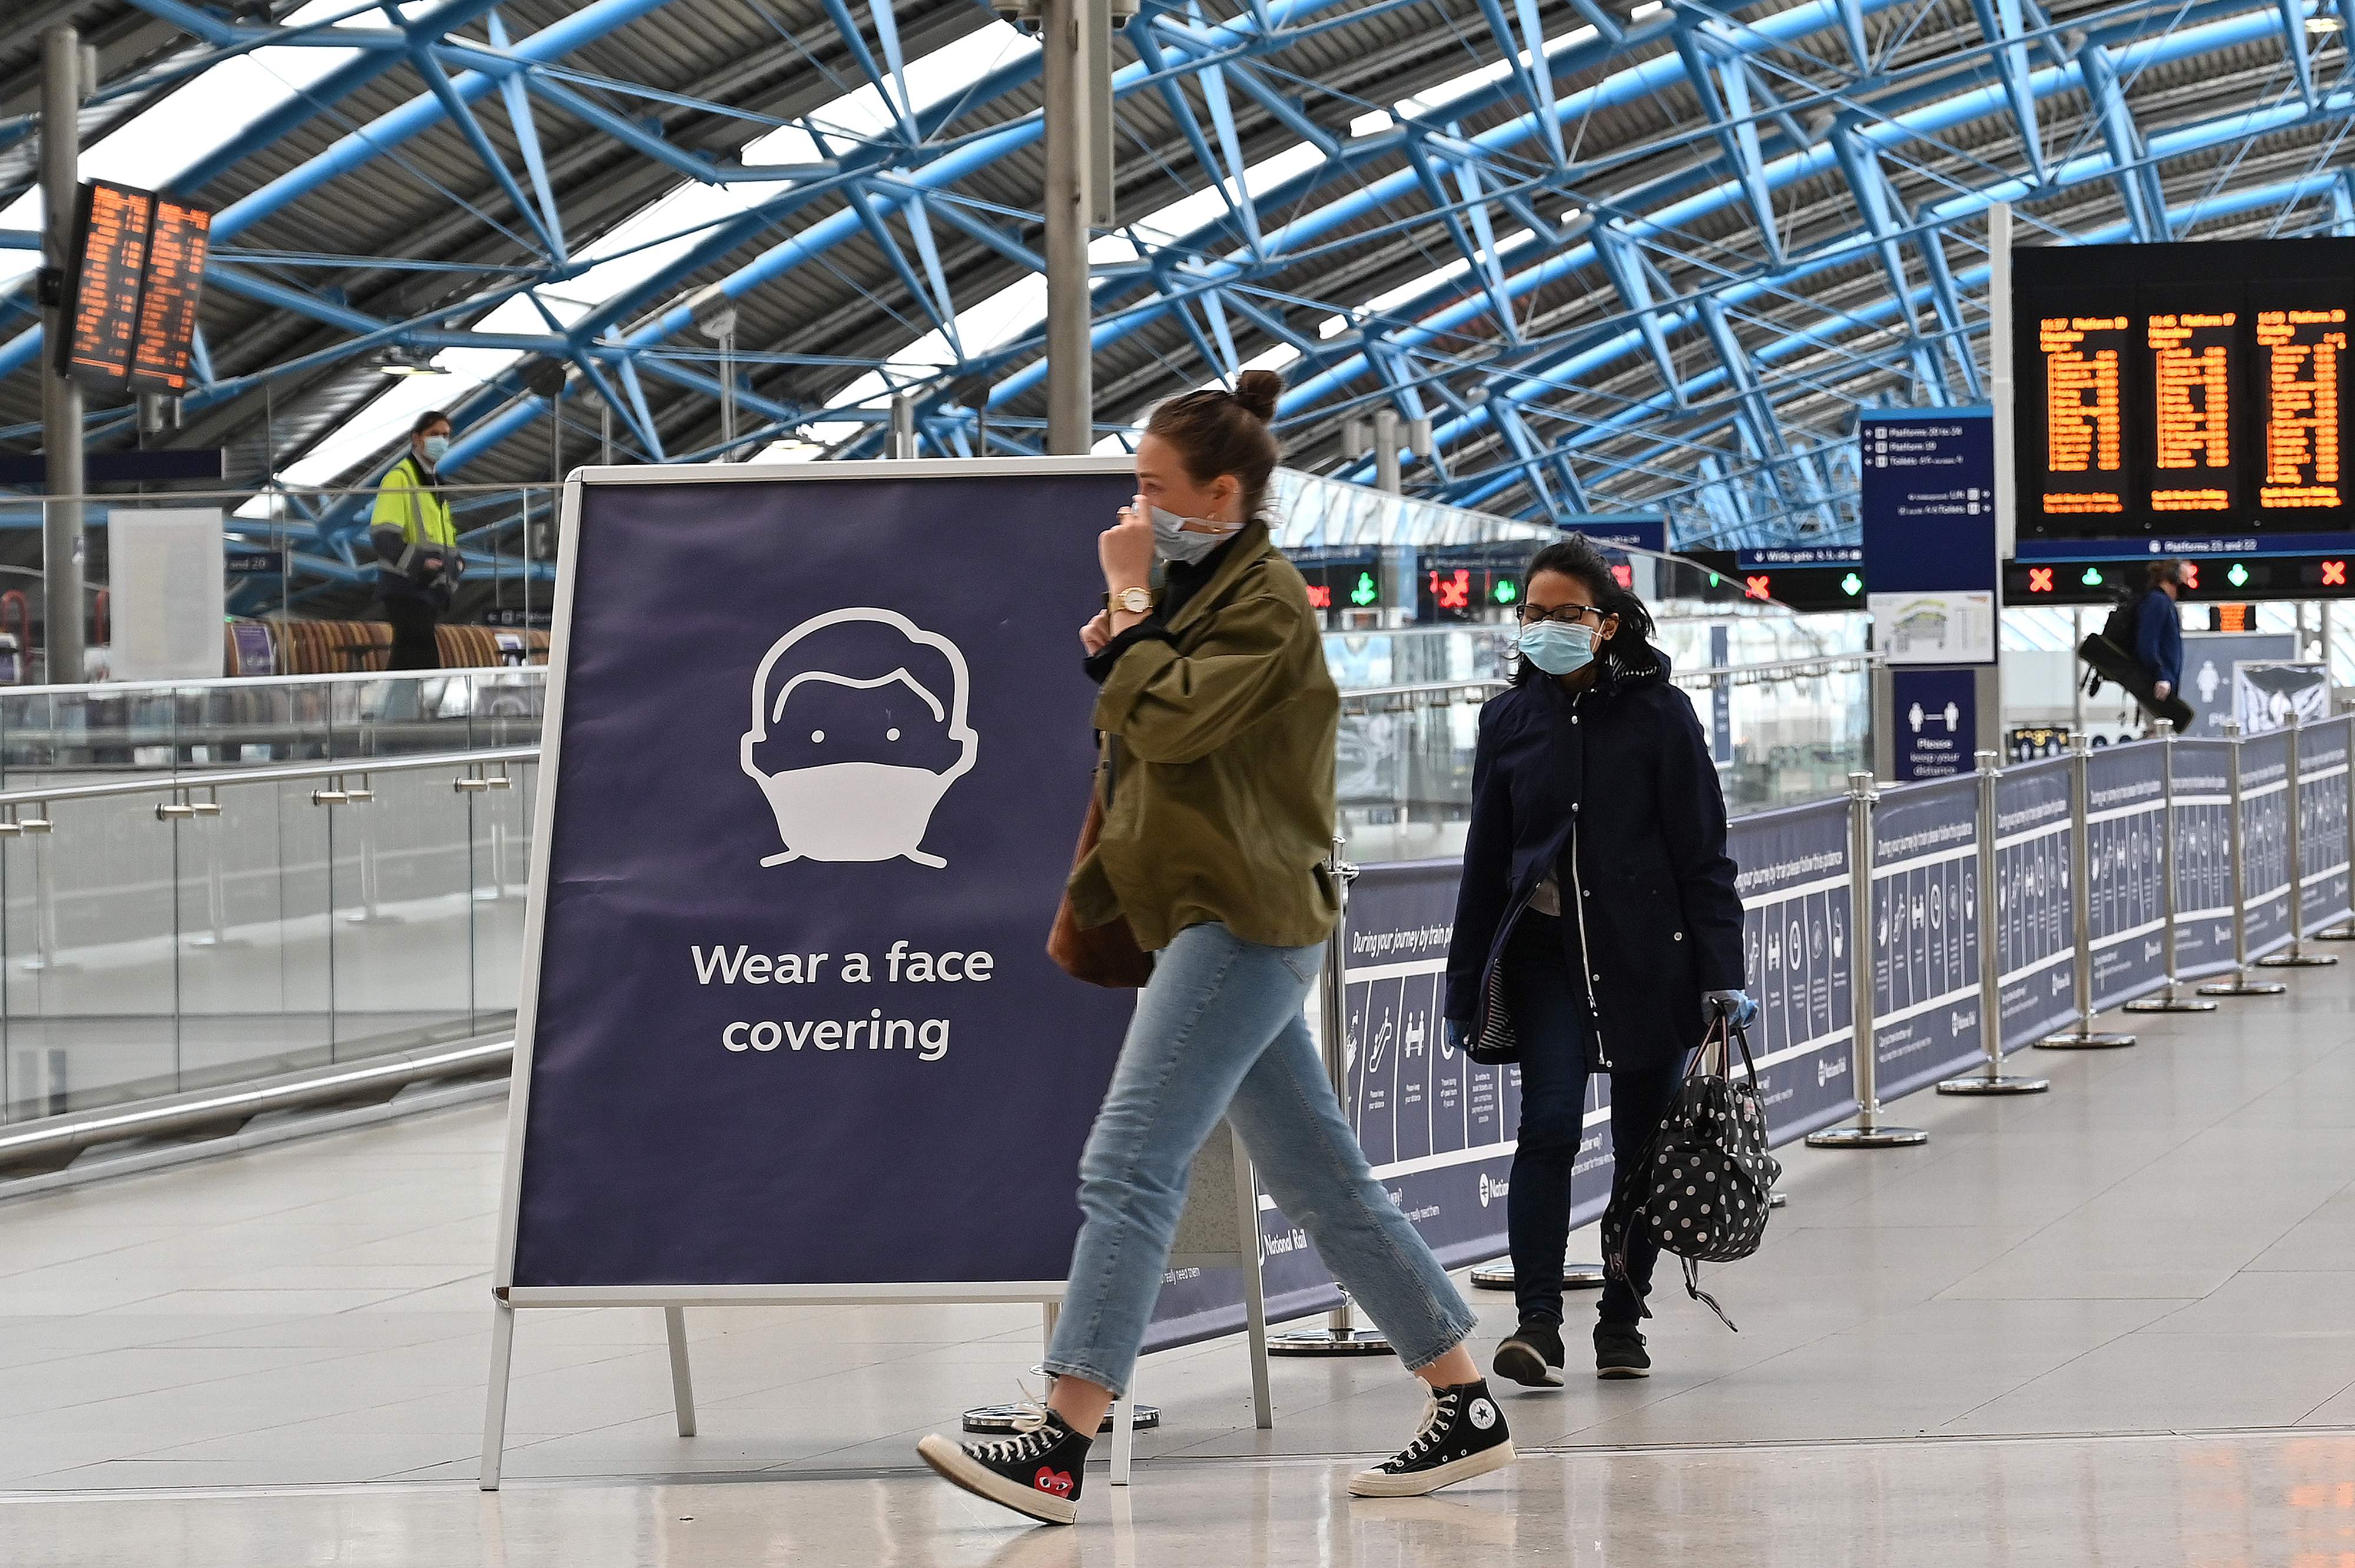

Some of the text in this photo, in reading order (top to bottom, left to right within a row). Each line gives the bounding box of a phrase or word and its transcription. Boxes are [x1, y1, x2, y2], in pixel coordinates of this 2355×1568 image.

[1889, 427, 1928, 438] Platforms
[1889, 442, 1925, 452] Platform
[2164, 541, 2210, 552] Platforms
[2224, 539, 2243, 551] and
[1791, 551, 1815, 563] gate
[1917, 738, 1953, 750] Please
[1910, 751, 1960, 765] keep your
[1913, 765, 1958, 776] distance
[1353, 930, 1377, 958] During
[1375, 932, 1394, 957] your
[1391, 927, 1420, 954] journey
[1419, 925, 1429, 952] by
[1428, 923, 1444, 946] train
[690, 940, 995, 985] Wear a face
[722, 1007, 951, 1062] covering
[1263, 1228, 1308, 1256] National Rail
